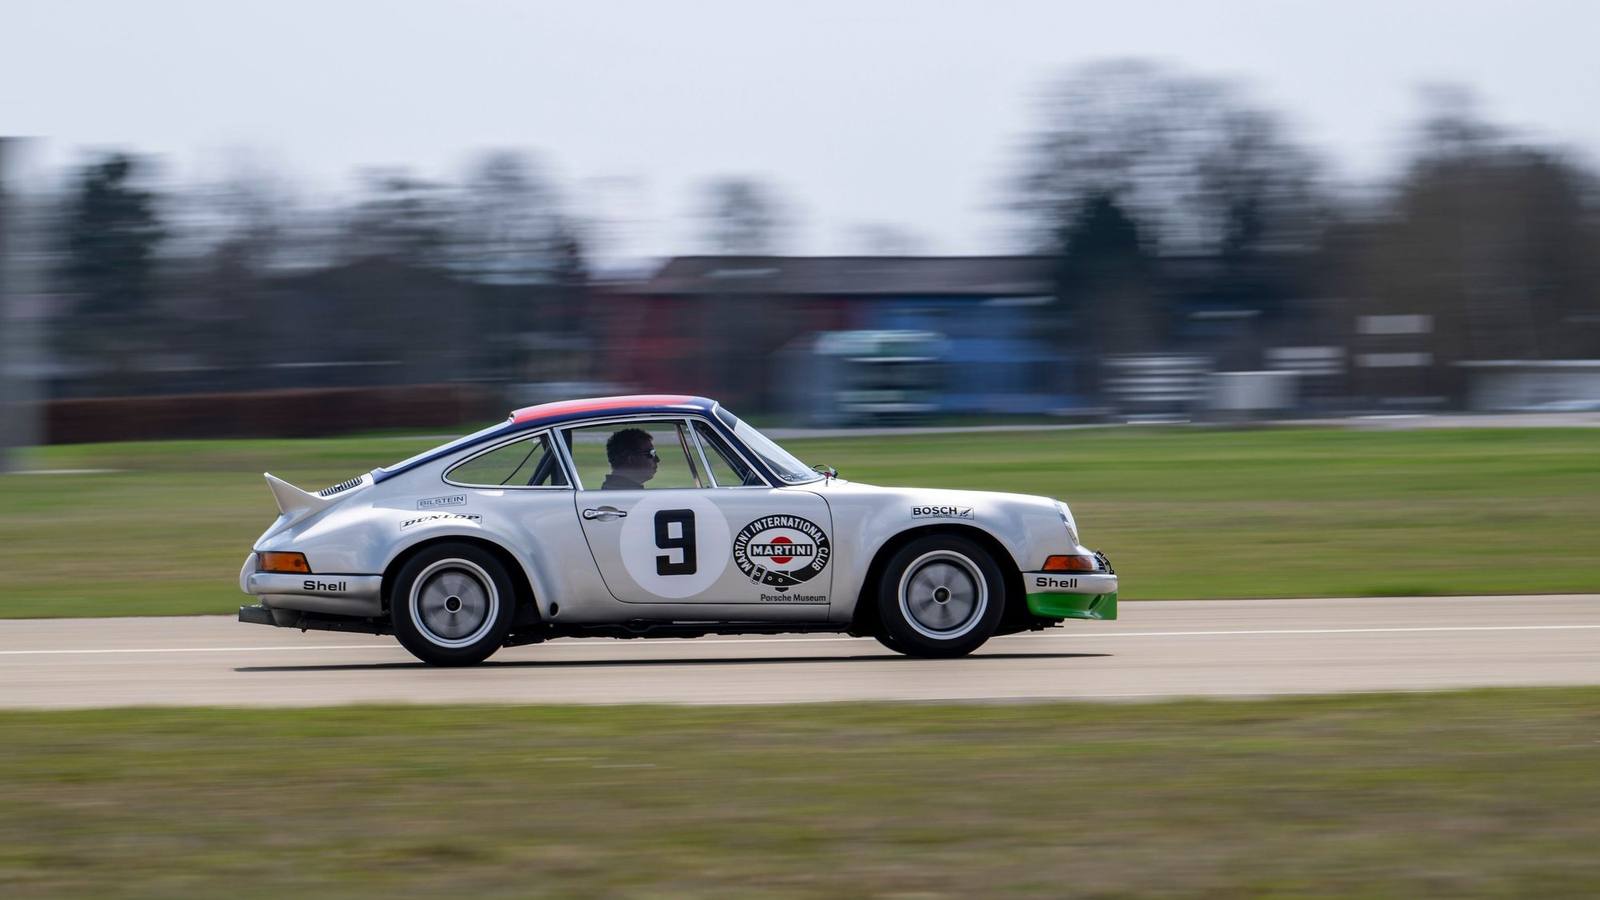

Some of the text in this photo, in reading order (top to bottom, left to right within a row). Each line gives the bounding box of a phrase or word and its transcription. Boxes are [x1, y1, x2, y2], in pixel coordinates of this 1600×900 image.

[420, 496, 464, 506] BILSTEIN
[913, 507, 957, 515] BOSCH
[402, 514, 480, 527] DUNLOP
[654, 509, 697, 576] 9
[735, 516, 829, 572] MARTINI INTERNATIONAL CLUB
[752, 545, 811, 555] MARTINI
[303, 580, 346, 591] Shell
[1036, 577, 1077, 588] Shell
